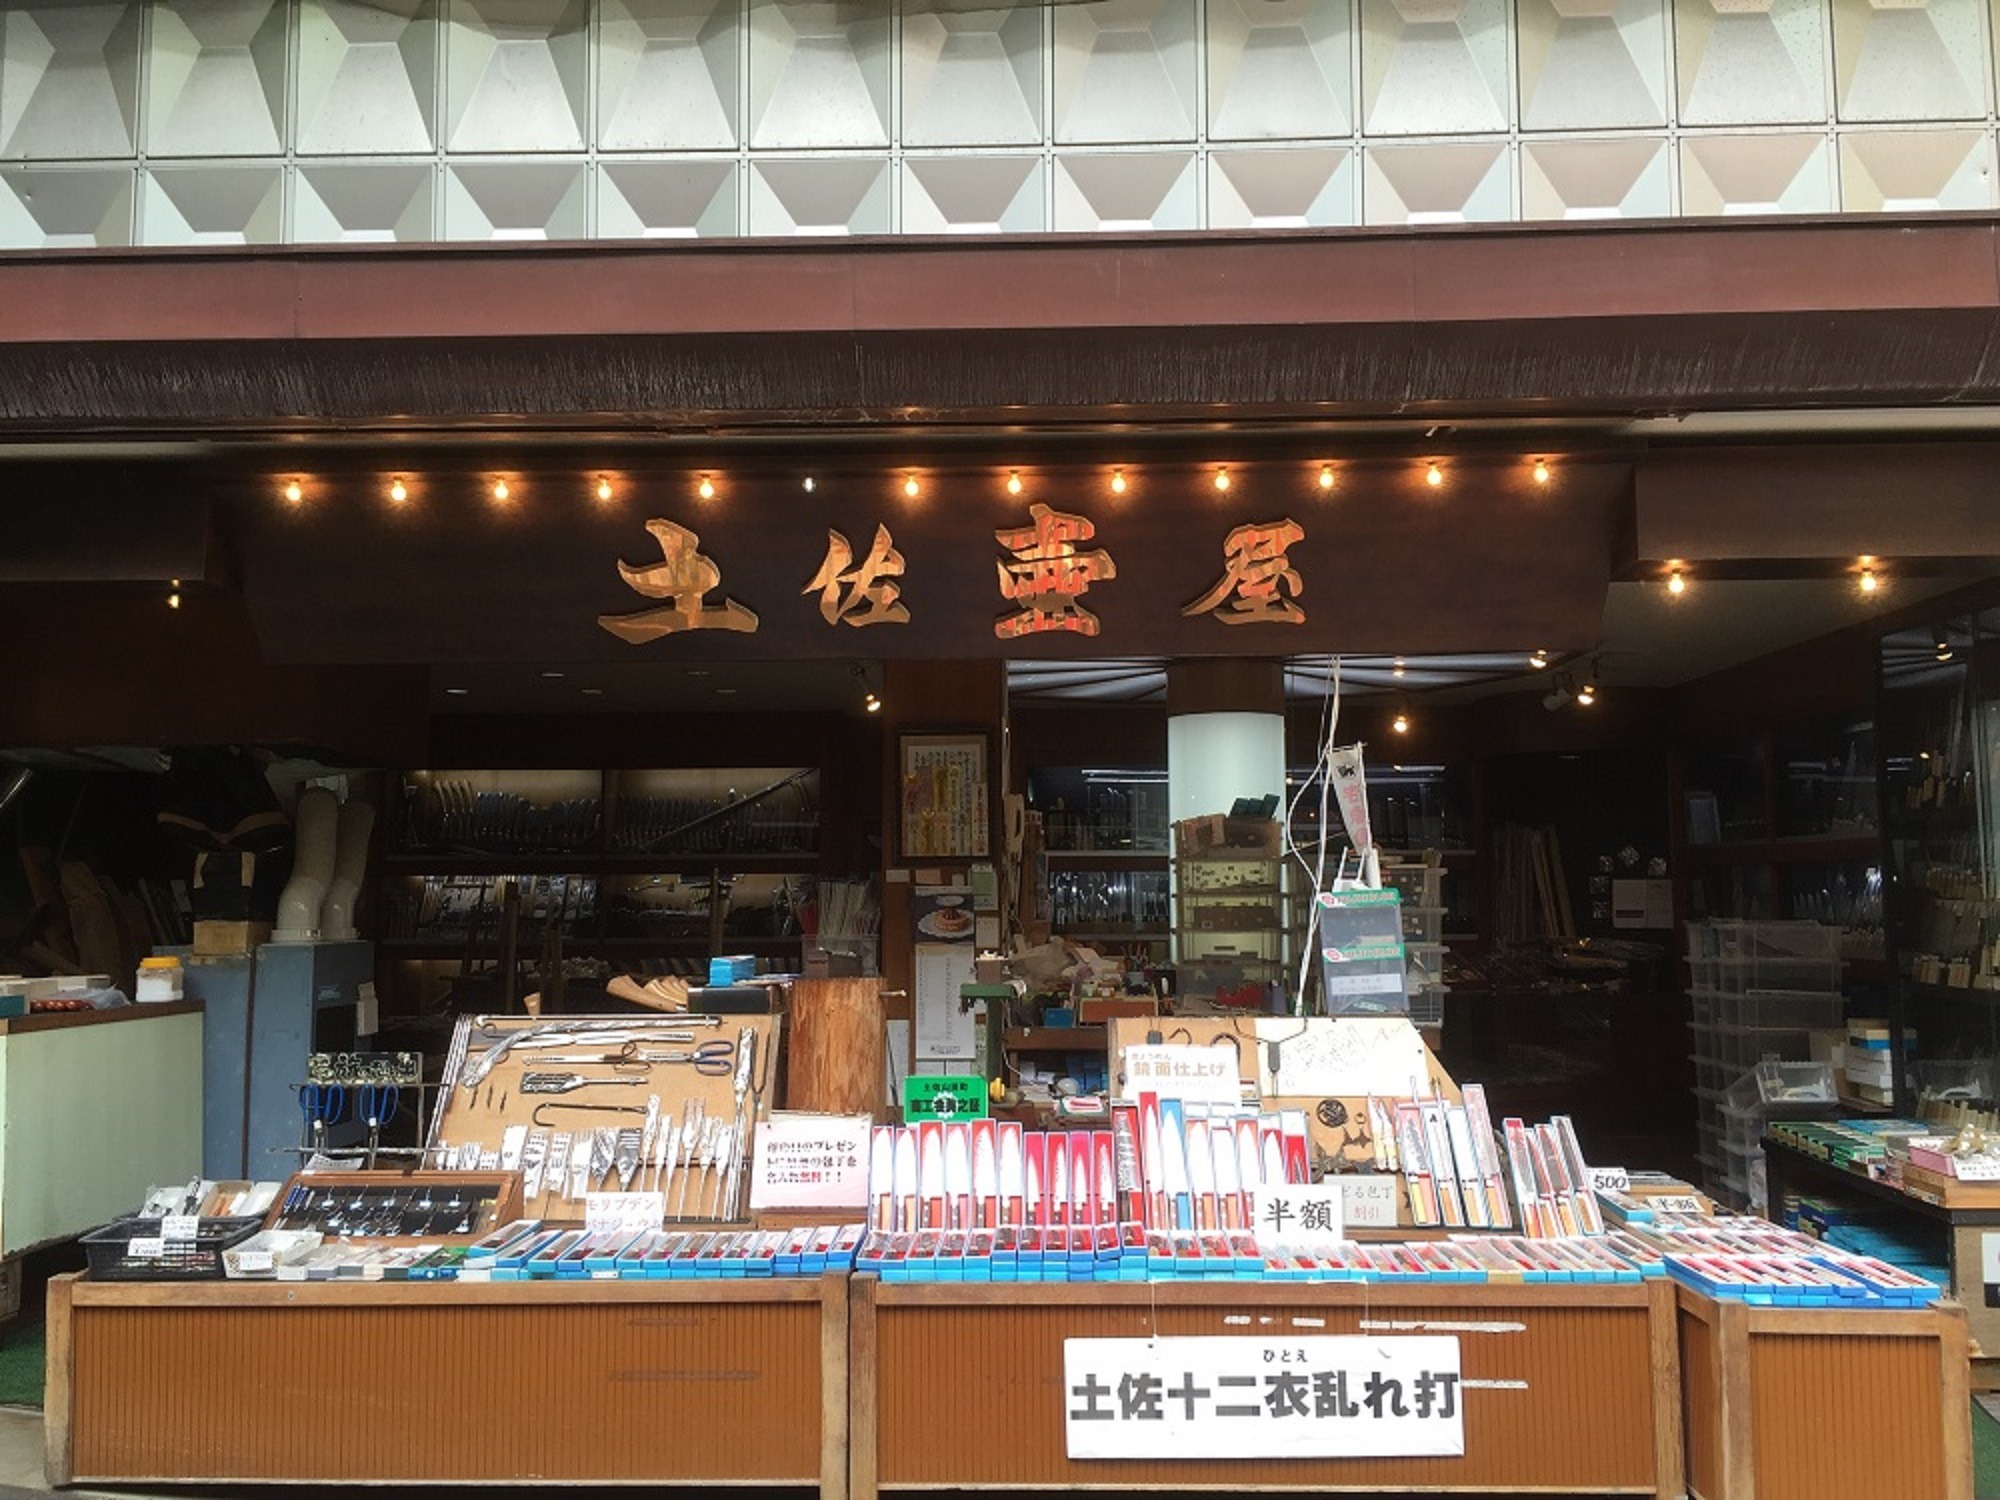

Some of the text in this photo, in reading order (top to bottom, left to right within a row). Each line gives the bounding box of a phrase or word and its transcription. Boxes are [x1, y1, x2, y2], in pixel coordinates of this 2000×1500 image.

[1133, 1061, 1226, 1077] 鏡面仕上げ
[586, 1197, 656, 1212] モリブデン
[1263, 1197, 1334, 1233] 半額
[1262, 1349, 1309, 1363] ひとえ
[1070, 1370, 1459, 1421] 土佐十二衣乱れ打
